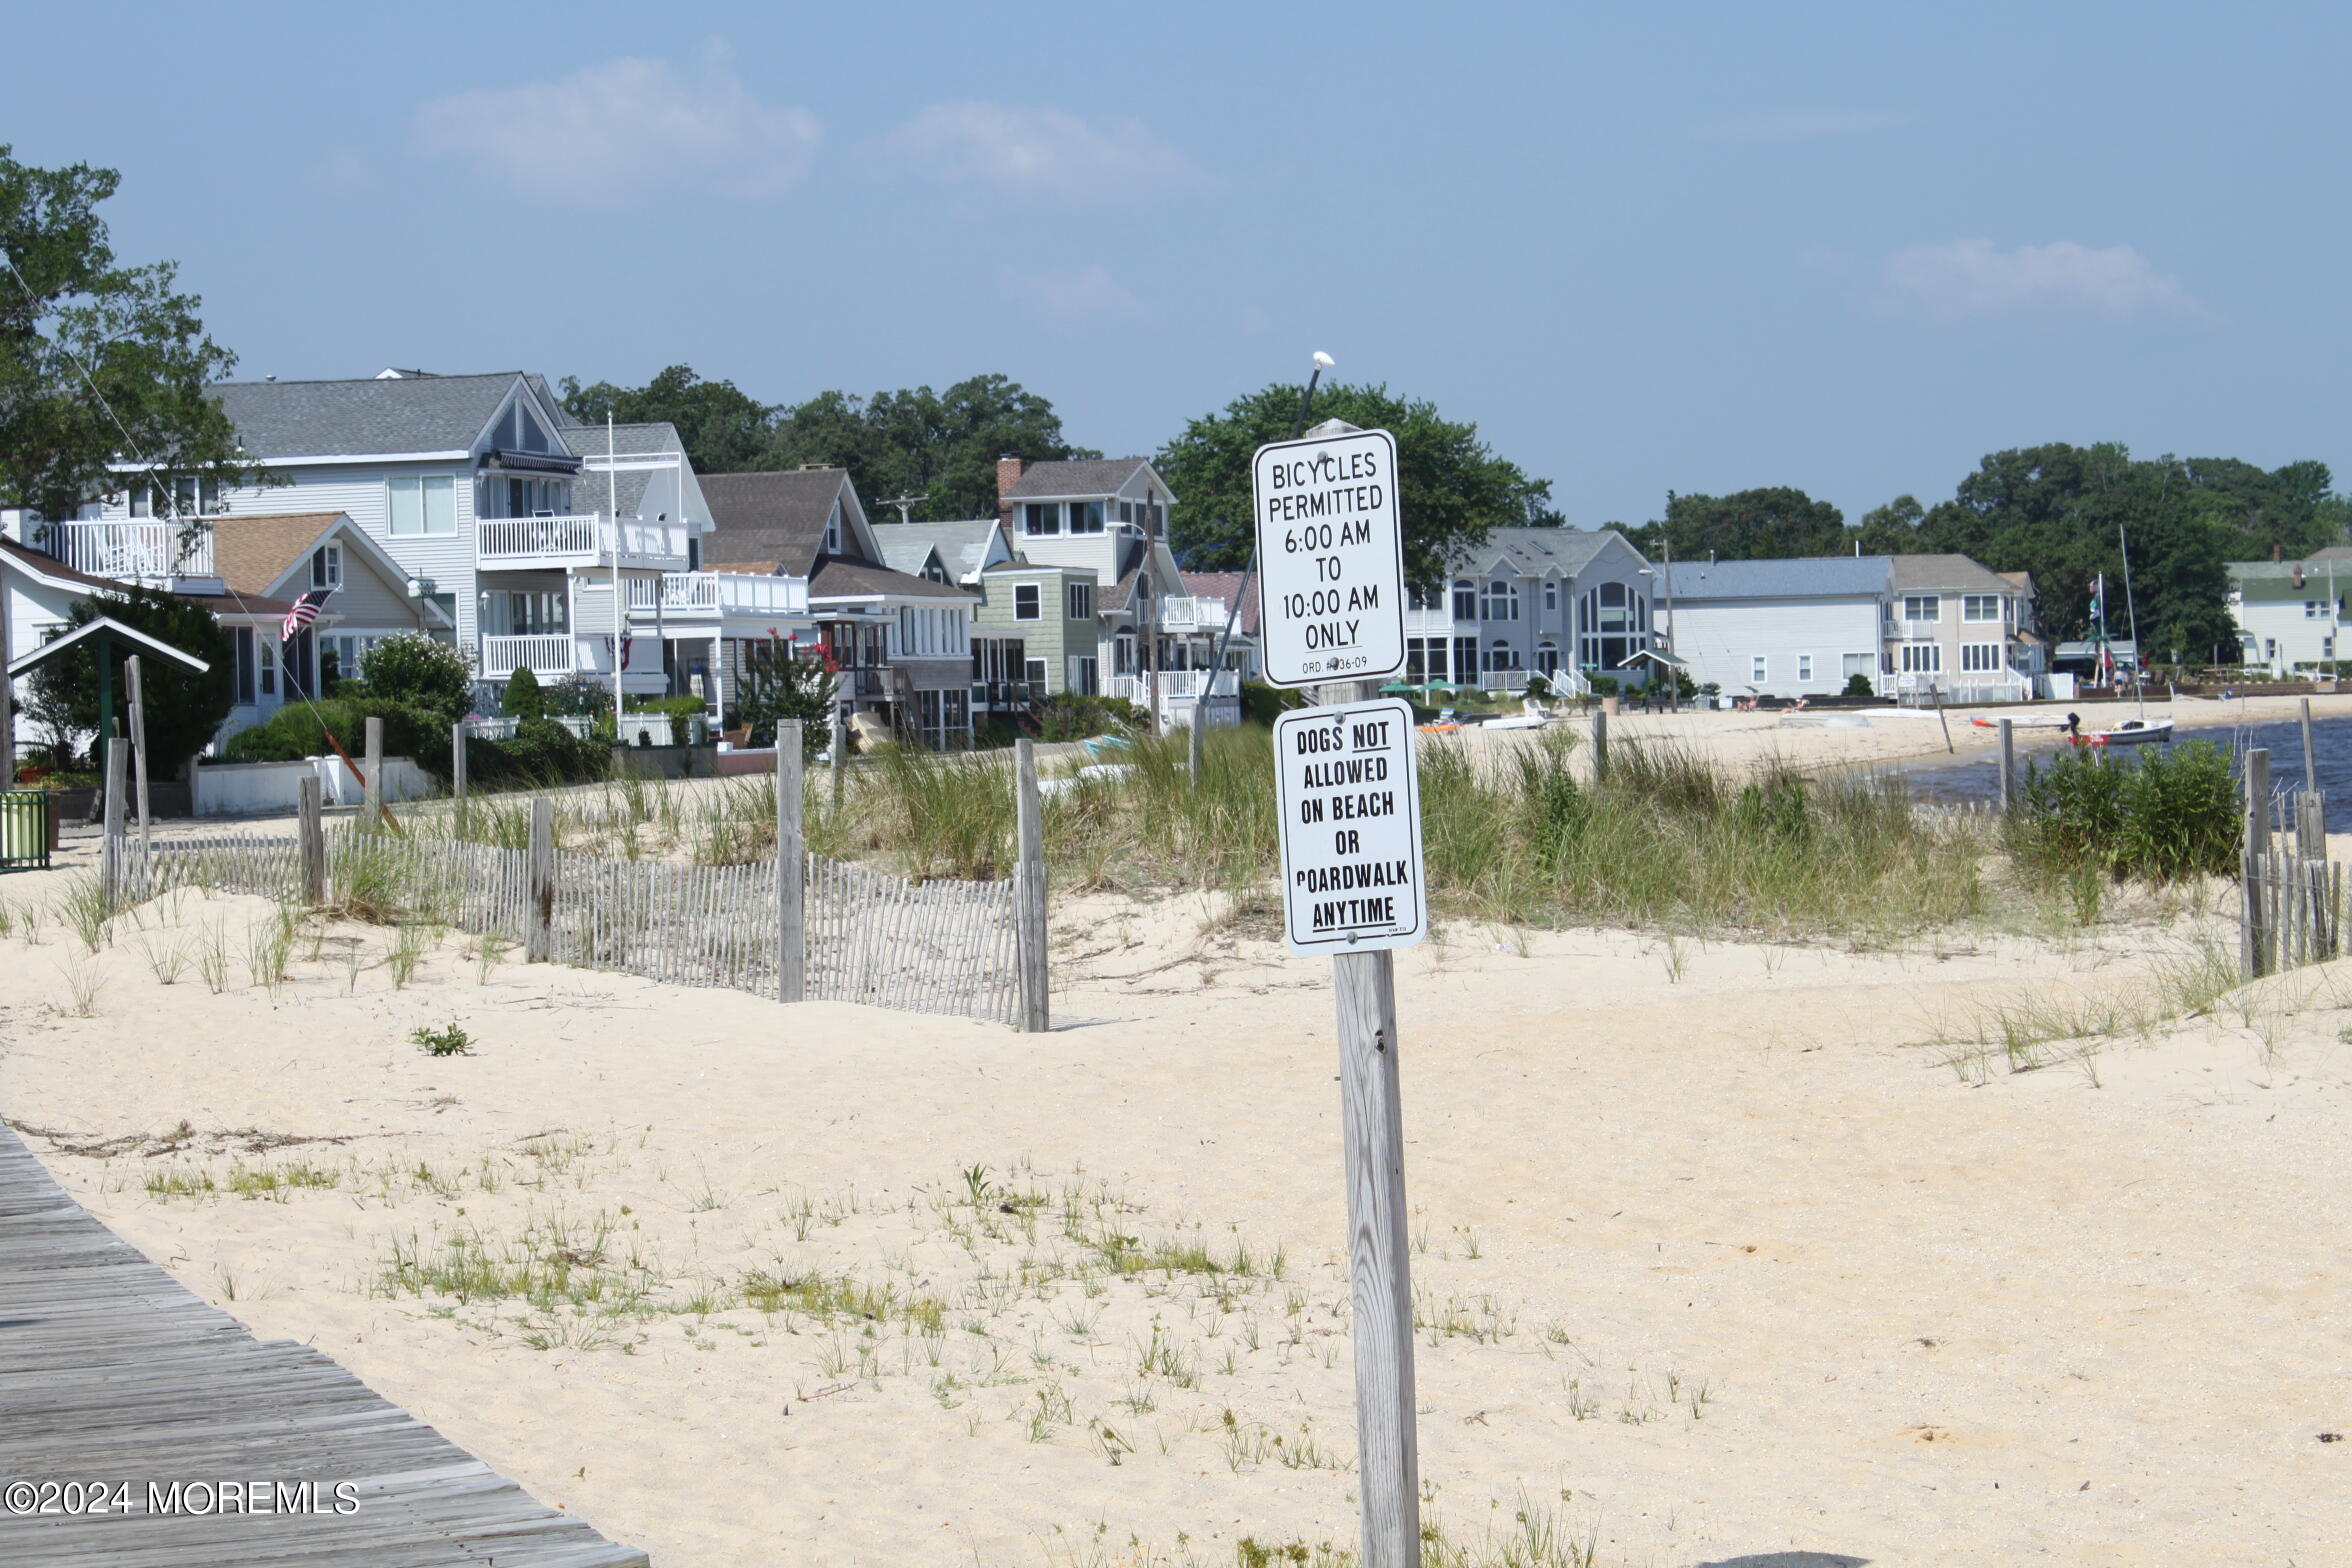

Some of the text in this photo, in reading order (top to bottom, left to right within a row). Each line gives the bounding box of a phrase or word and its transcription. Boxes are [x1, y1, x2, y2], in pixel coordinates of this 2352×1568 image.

[1272, 452, 1377, 490] BICYCLES
[1269, 484, 1383, 523] PERMITTED
[1284, 518, 1371, 554] 6:00 AM
[1315, 555, 1342, 583] TO
[1283, 584, 1379, 620] 10:00 AM
[1305, 619, 1360, 650] ONLY
[1302, 656, 1368, 674] ORD. #36-09
[1296, 721, 1390, 755] DOGS NOT
[1303, 757, 1388, 789] ALLOWED
[1301, 791, 1394, 825] ON BEACH
[1335, 829, 1360, 855] OR
[1312, 896, 1396, 928] ANYTIME
